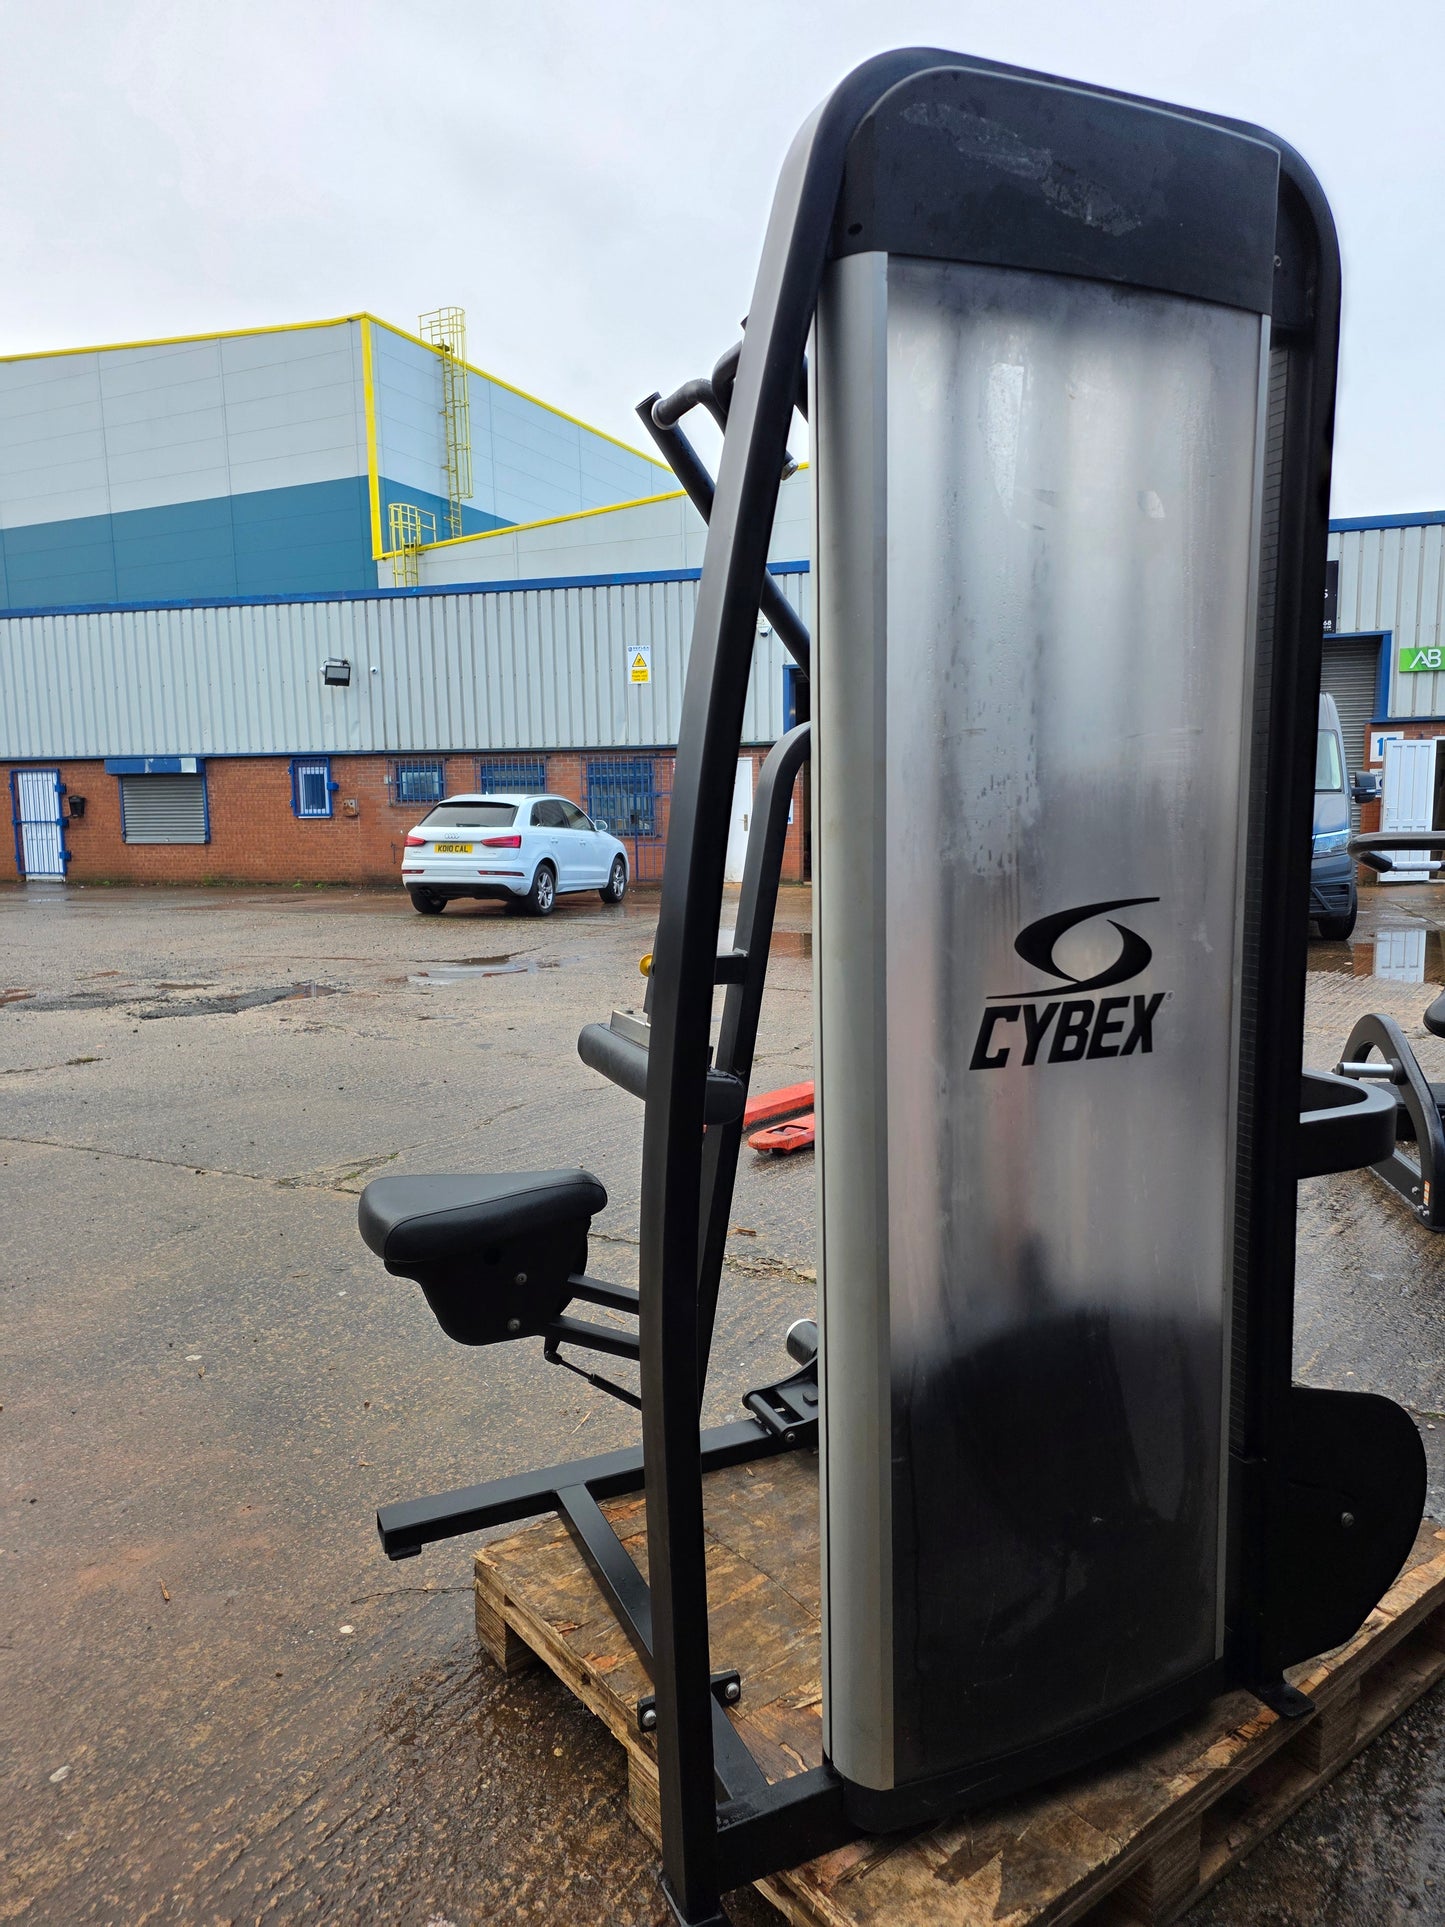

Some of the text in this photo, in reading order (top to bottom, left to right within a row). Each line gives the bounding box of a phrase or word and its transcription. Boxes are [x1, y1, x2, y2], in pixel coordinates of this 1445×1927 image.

[1409, 648, 1442, 669] AB
[1377, 736, 1397, 757] 1
[455, 845, 469, 853] CAL
[969, 992, 1166, 1071] CYBEX
